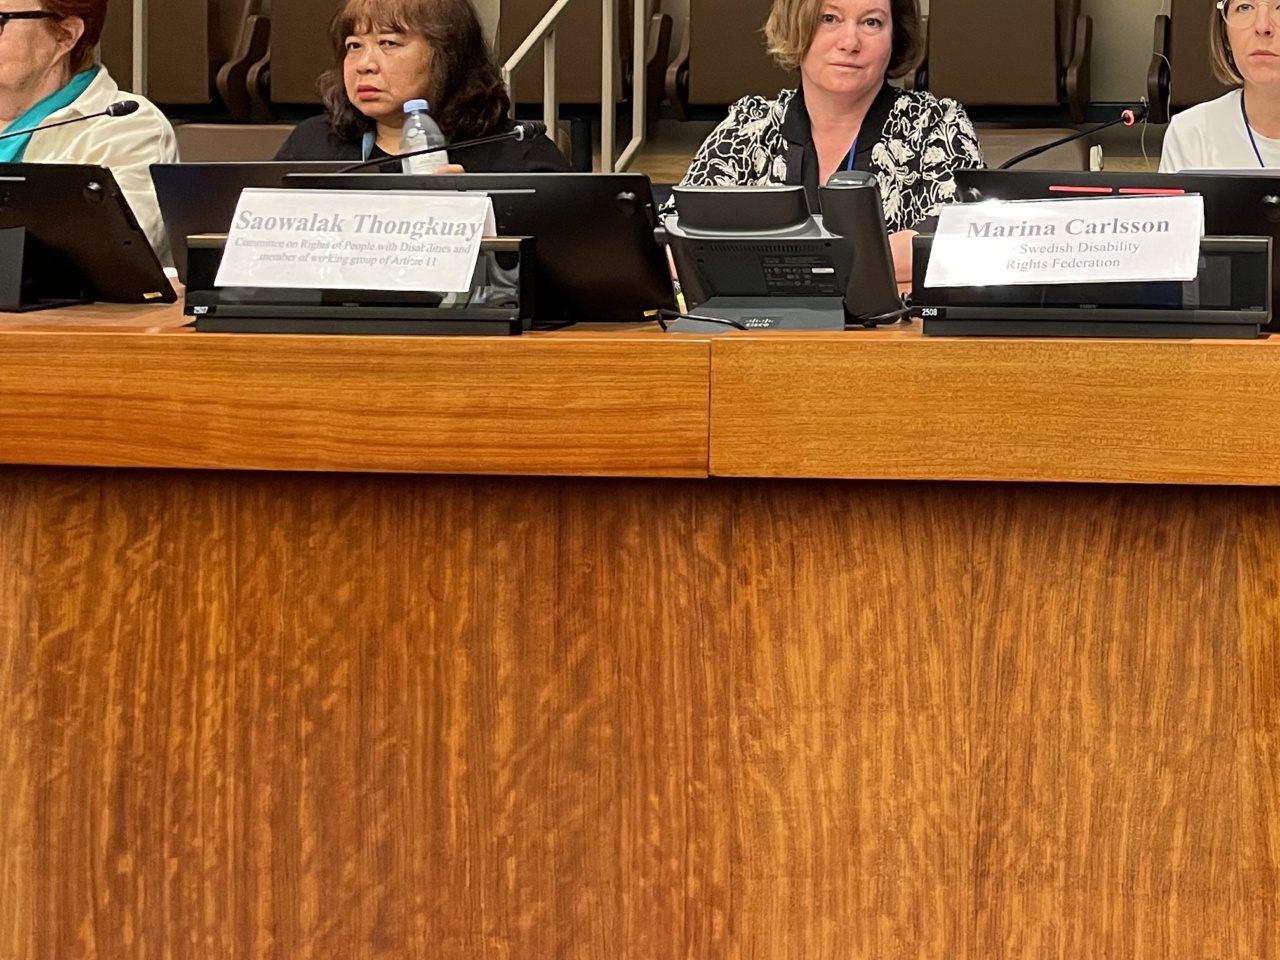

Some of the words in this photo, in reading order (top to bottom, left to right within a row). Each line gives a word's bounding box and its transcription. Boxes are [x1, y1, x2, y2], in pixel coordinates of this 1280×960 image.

[235, 210, 345, 234] Saowalak
[353, 214, 481, 242] Thongkuay
[966, 221, 1056, 239] Marina
[1065, 218, 1171, 236] Carlsson
[344, 241, 375, 252] People
[377, 243, 398, 252] with
[453, 244, 472, 254] and
[1019, 243, 1074, 254] Swedish
[1078, 242, 1140, 254] Disability
[298, 253, 311, 263] of
[350, 256, 378, 267] group
[380, 254, 393, 266] of
[1006, 258, 1048, 272] Rights
[1052, 258, 1121, 270] Federation
